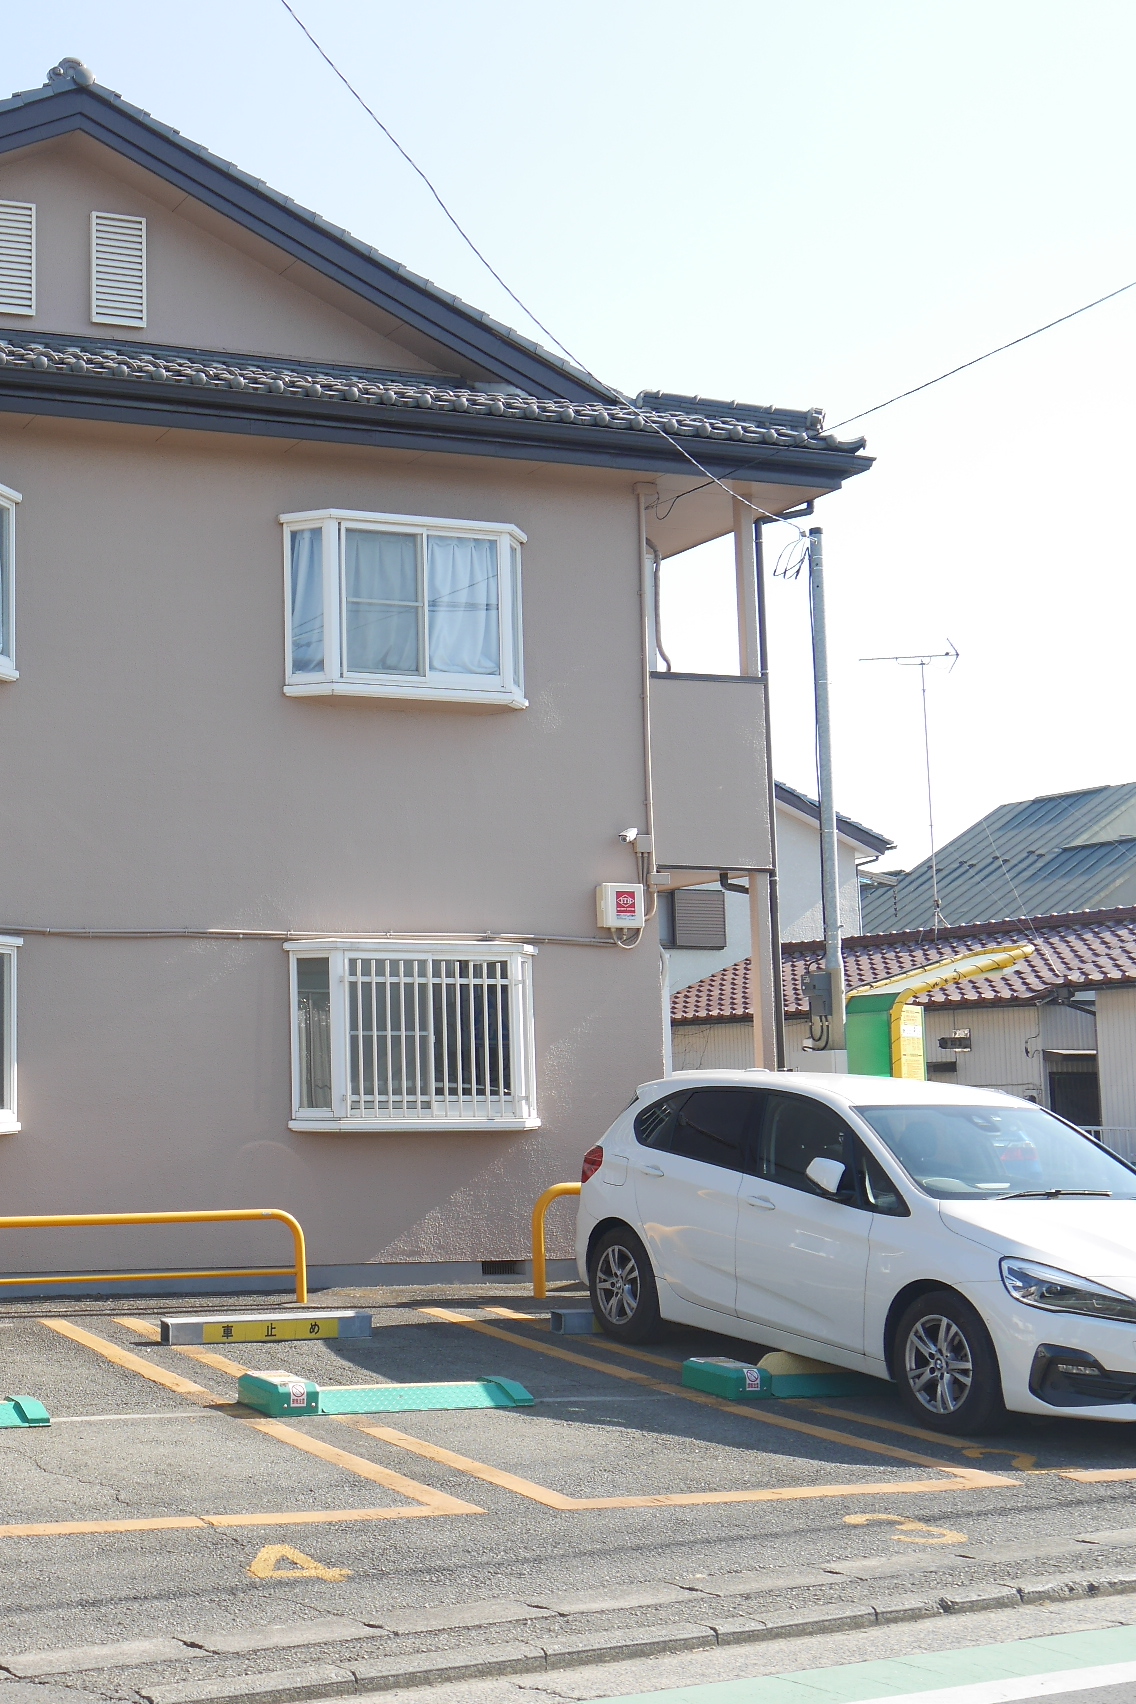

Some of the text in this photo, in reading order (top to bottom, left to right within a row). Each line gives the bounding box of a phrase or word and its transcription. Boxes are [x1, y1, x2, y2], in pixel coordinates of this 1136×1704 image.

[221, 1321, 320, 1340] 車止め
[842, 1513, 969, 1545] 3
[247, 1543, 355, 1583] 4
